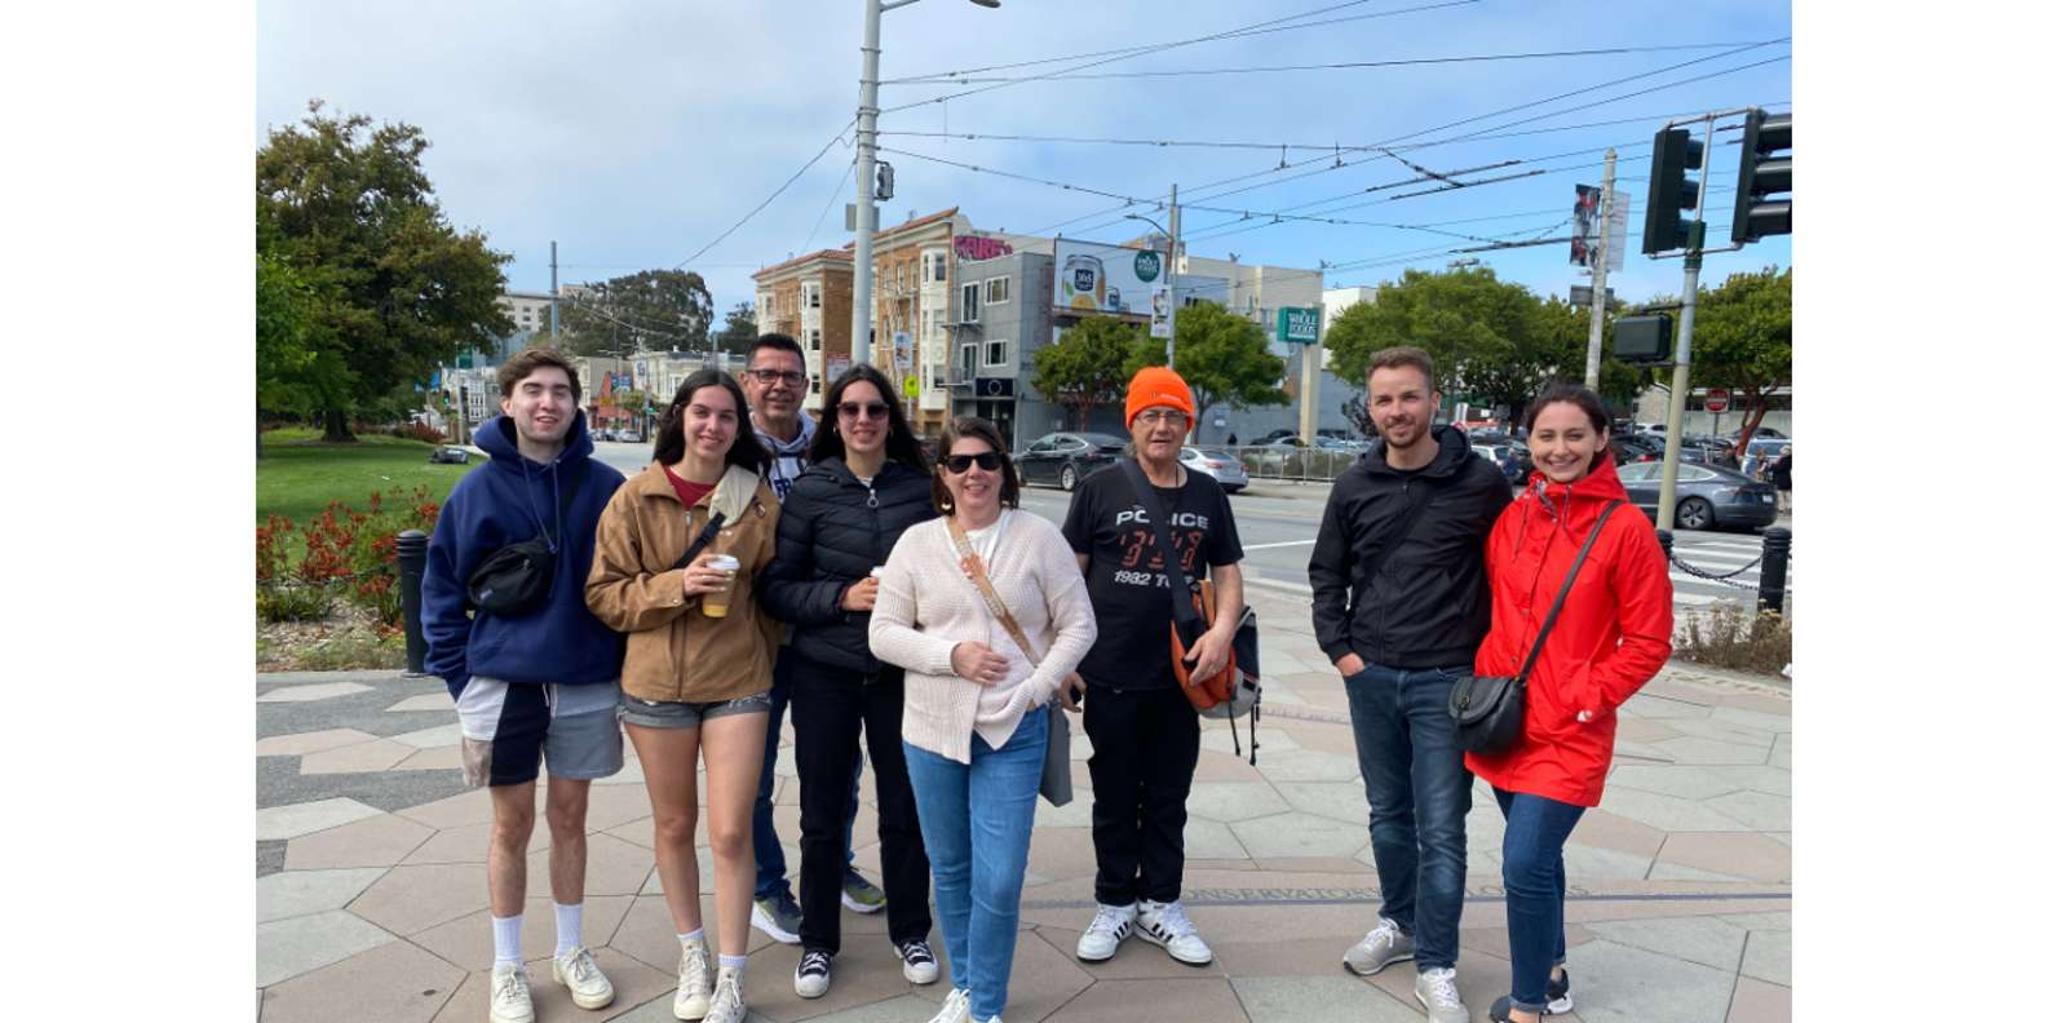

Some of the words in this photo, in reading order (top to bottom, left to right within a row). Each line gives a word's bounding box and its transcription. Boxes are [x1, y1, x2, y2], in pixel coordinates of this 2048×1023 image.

[1288, 311, 1316, 325] WHOLE
[1116, 510, 1208, 529] POICE
[1114, 570, 1152, 586] 1982
